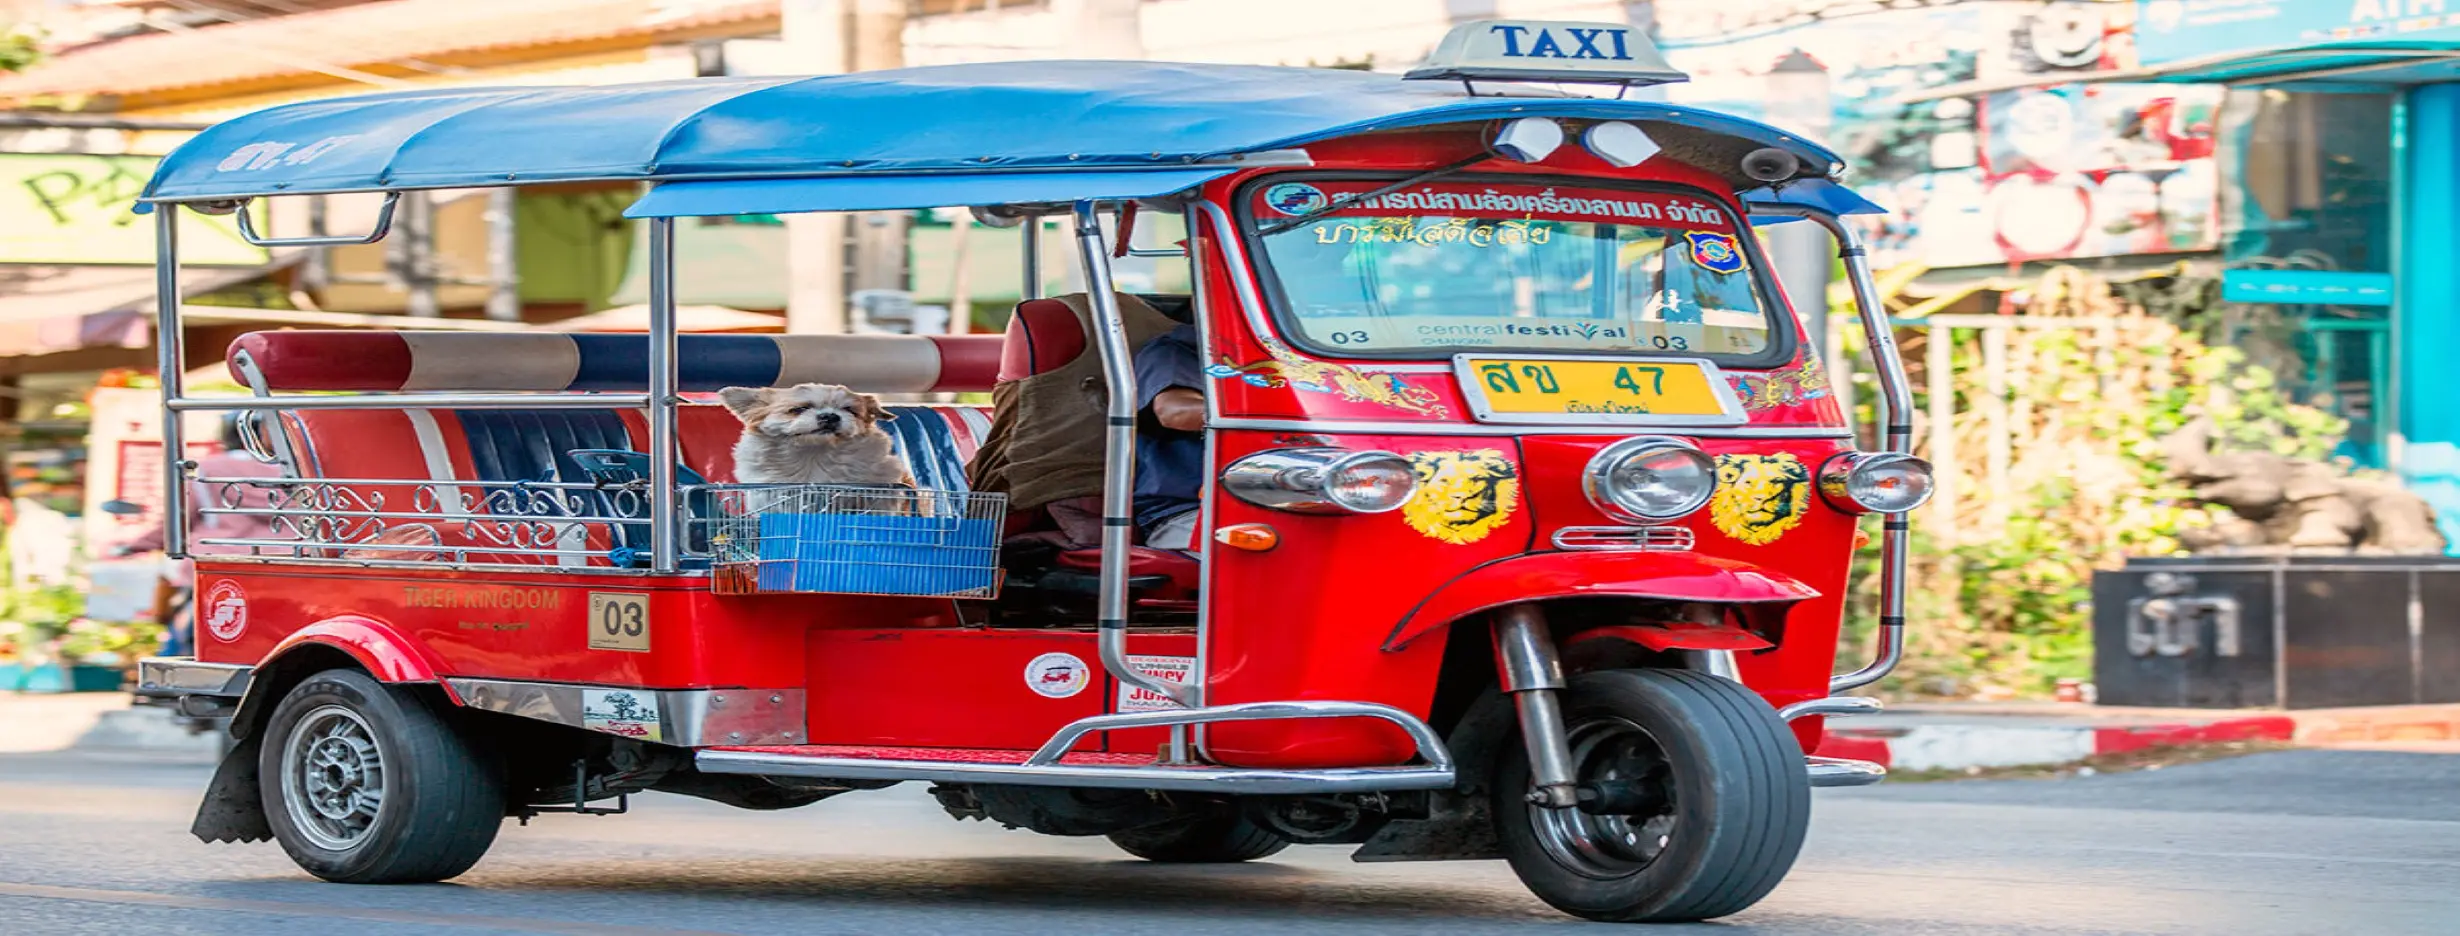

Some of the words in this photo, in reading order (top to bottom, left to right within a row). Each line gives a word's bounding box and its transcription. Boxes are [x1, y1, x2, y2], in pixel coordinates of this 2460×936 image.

[1490, 24, 1634, 61] TAXI
[1665, 200, 1723, 225] จำกัด
[1330, 330, 1370, 345] 03
[1651, 335, 1689, 350] 03
[1481, 362, 1560, 394] สข
[1613, 366, 1665, 396] 47
[403, 586, 458, 608] TIGER
[463, 588, 560, 609] KINGDOM
[603, 600, 643, 636] 03
